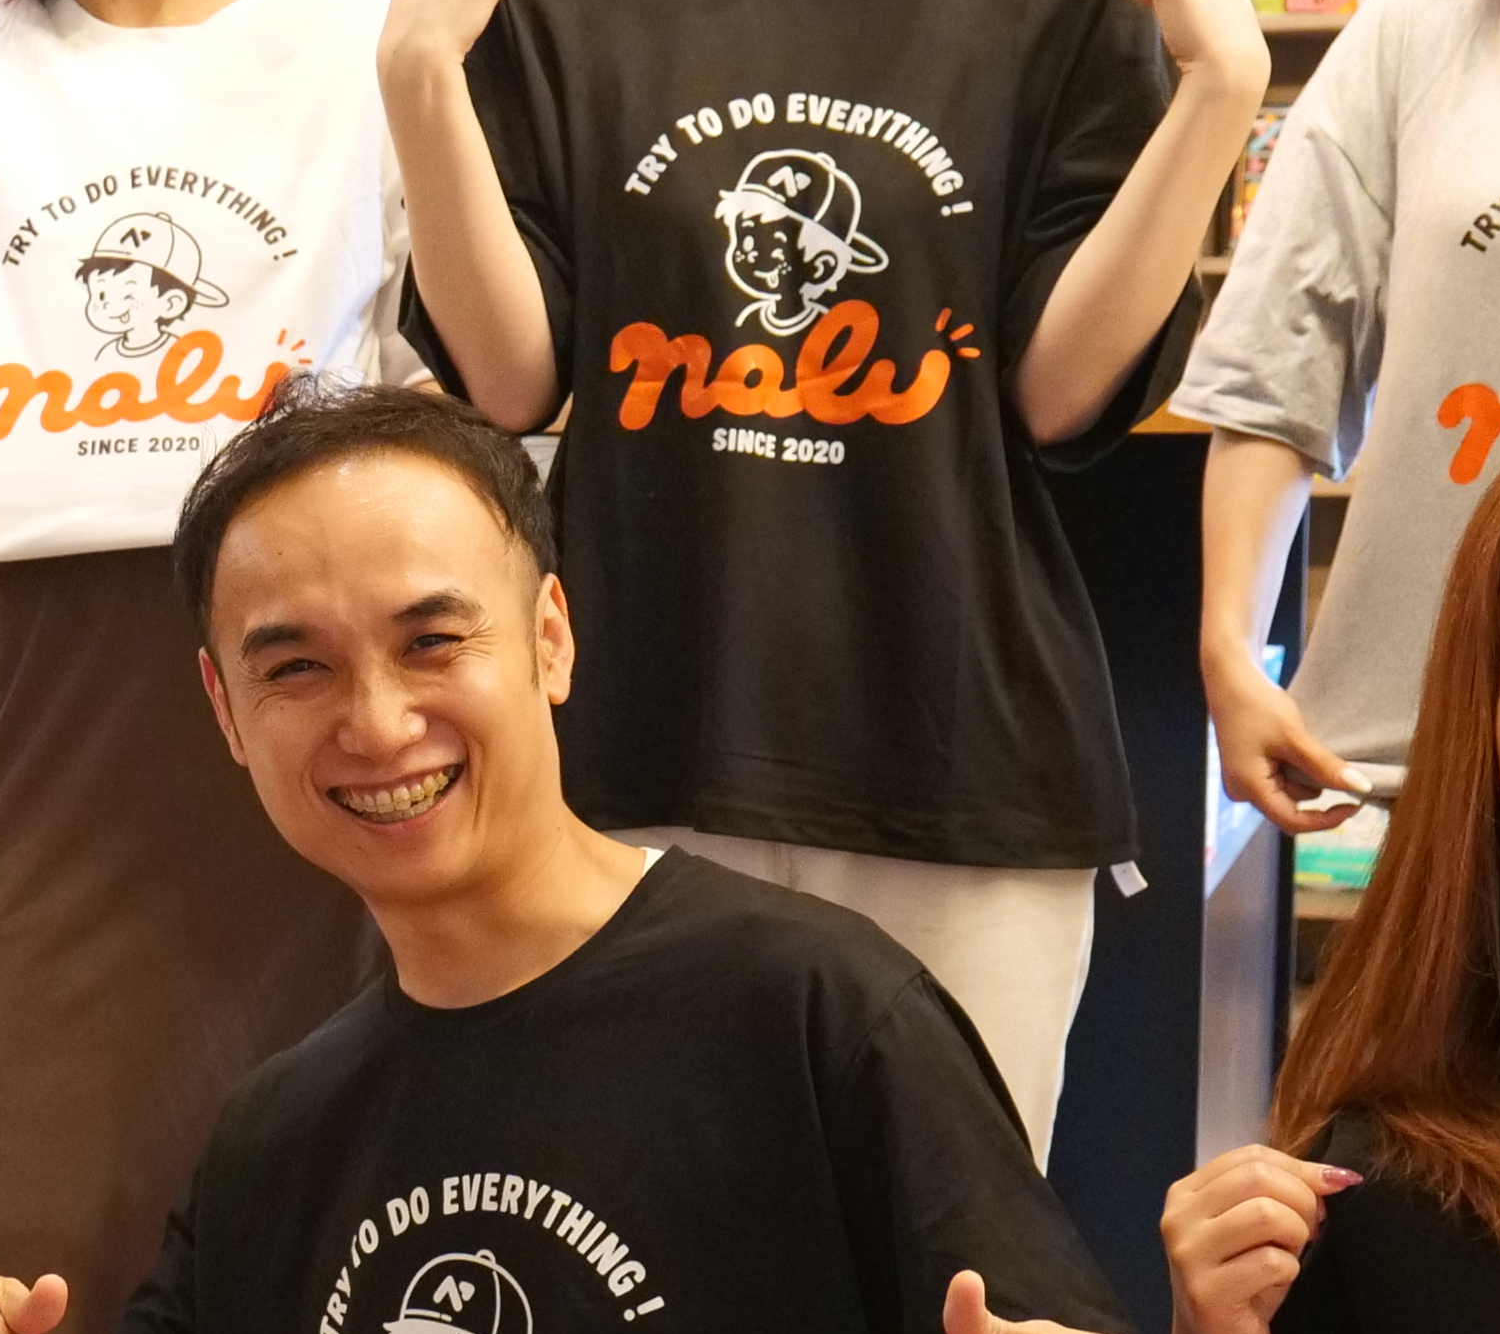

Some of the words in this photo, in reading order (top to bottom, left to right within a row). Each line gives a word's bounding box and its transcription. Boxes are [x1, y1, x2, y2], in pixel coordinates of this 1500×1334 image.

[624, 133, 678, 196] TRY
[676, 106, 723, 145] TO
[727, 92, 775, 129] DO
[2, 218, 40, 268] TRY
[41, 194, 76, 222] TO
[85, 174, 119, 204] DO
[609, 299, 951, 431] nalu
[77, 437, 138, 456] SINCE
[148, 436, 200, 453] 2020
[712, 427, 776, 459] SINCE
[782, 437, 846, 465] 2020
[350, 1218, 380, 1269] TO
[386, 1186, 430, 1236] DO
